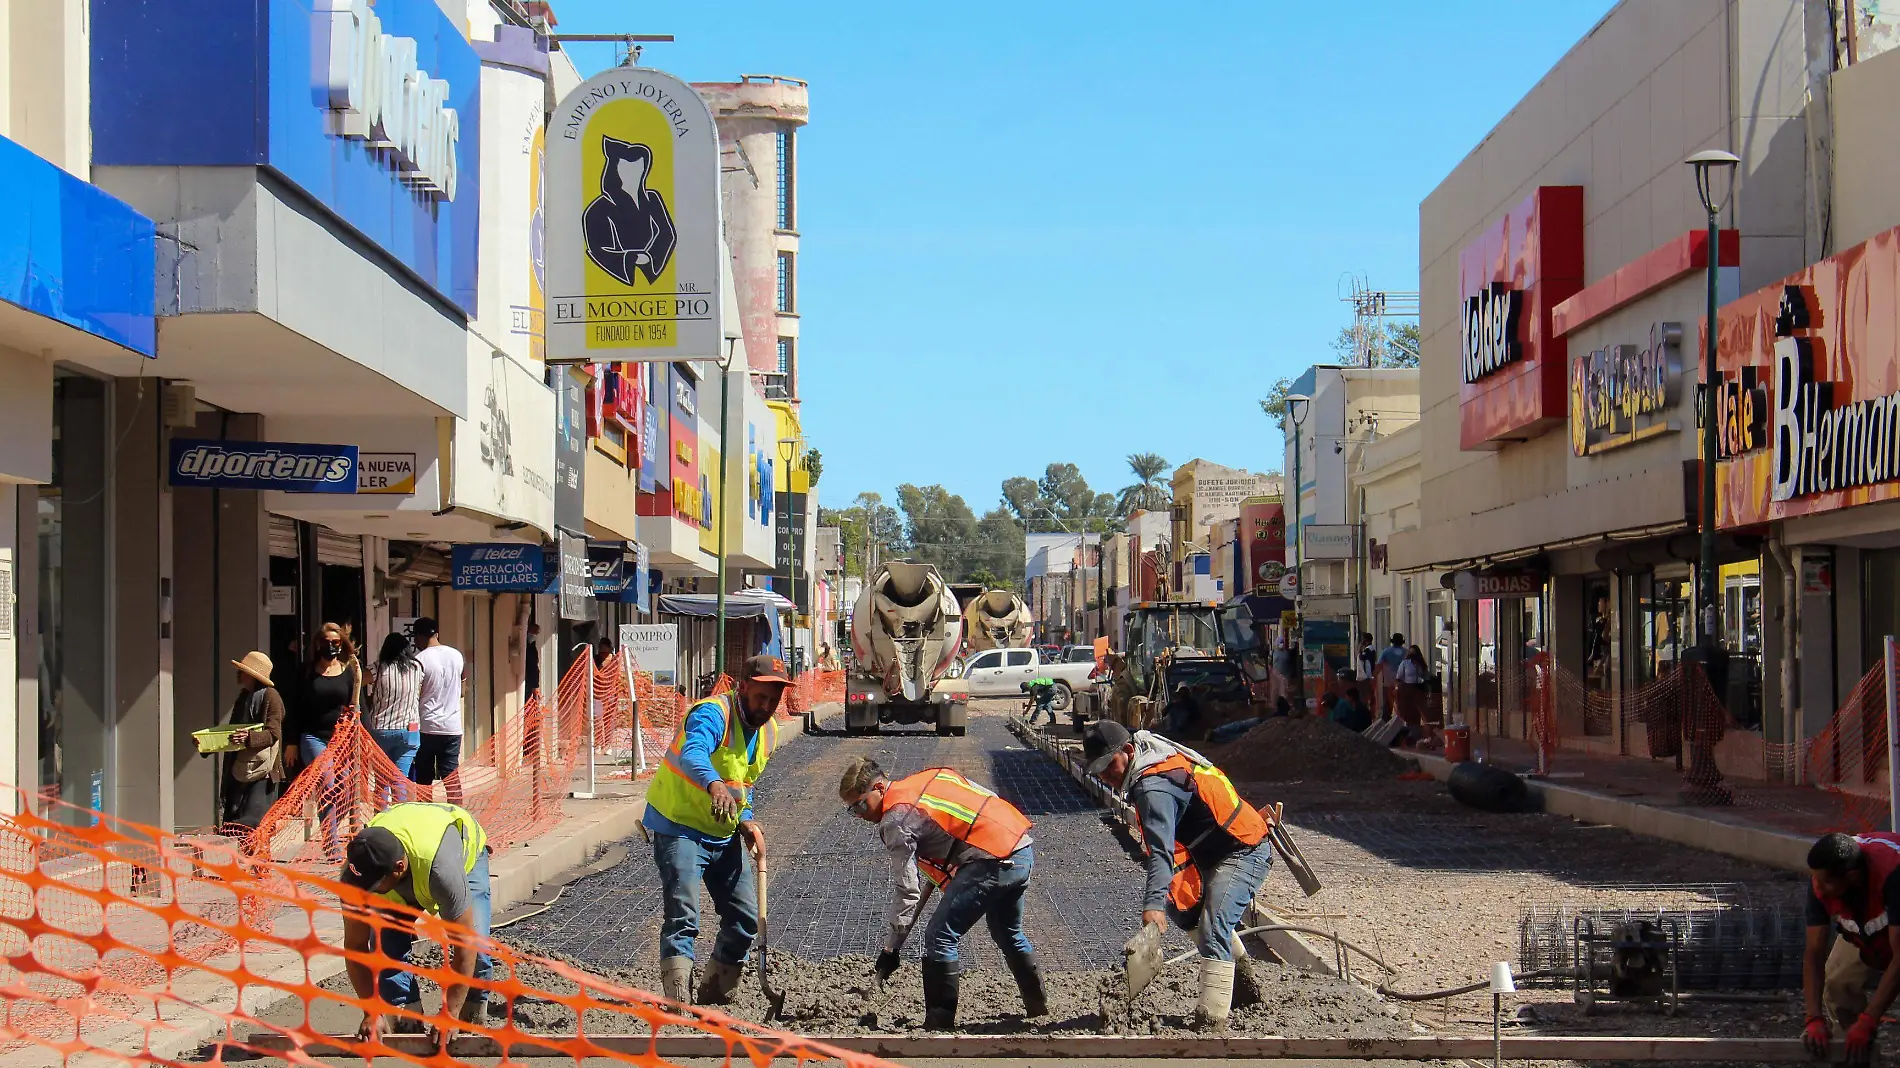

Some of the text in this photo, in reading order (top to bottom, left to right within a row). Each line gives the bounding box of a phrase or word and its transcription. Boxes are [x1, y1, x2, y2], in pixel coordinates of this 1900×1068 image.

[563, 81, 690, 141] EMPEÑO Y JOYERIA
[678, 282, 700, 293] MR.
[556, 299, 709, 319] EL MONGE PIO
[596, 324, 667, 341] FUNDADO EN 1954
[177, 445, 352, 483] dportenis
[368, 461, 412, 473] NUEVA
[358, 476, 388, 488] LER
[485, 547, 525, 560] telcel
[782, 542, 797, 552] OO
[462, 560, 534, 575] REPARACIÓN
[782, 556, 802, 567] PLTA
[457, 575, 472, 586] DE
[475, 573, 538, 585] CELULARES
[1478, 576, 1531, 593] ROJAS
[621, 630, 673, 643] COMPRO
